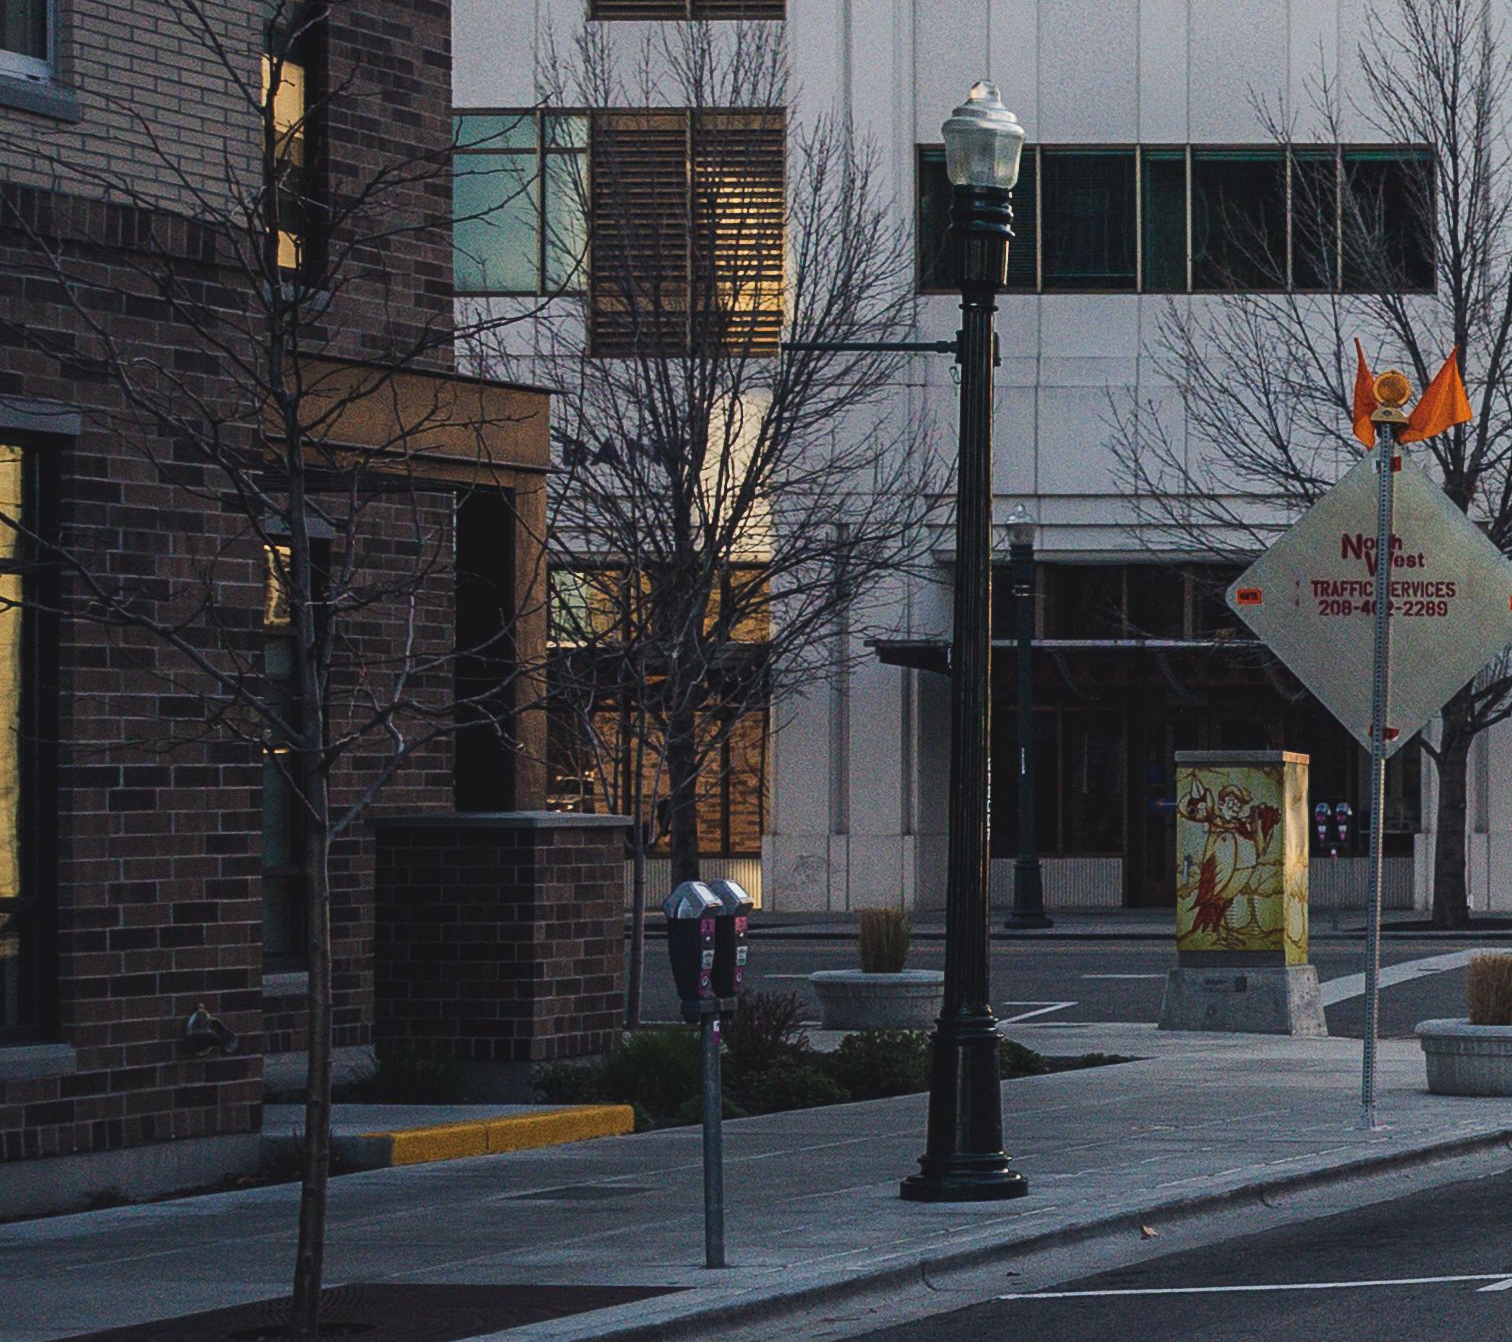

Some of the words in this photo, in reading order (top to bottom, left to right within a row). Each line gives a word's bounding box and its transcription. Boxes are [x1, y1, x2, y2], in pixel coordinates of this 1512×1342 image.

[1341, 532, 1403, 560] Noh
[1311, 580, 1374, 598] TRAFFIC
[1385, 581, 1456, 598] ERVICES
